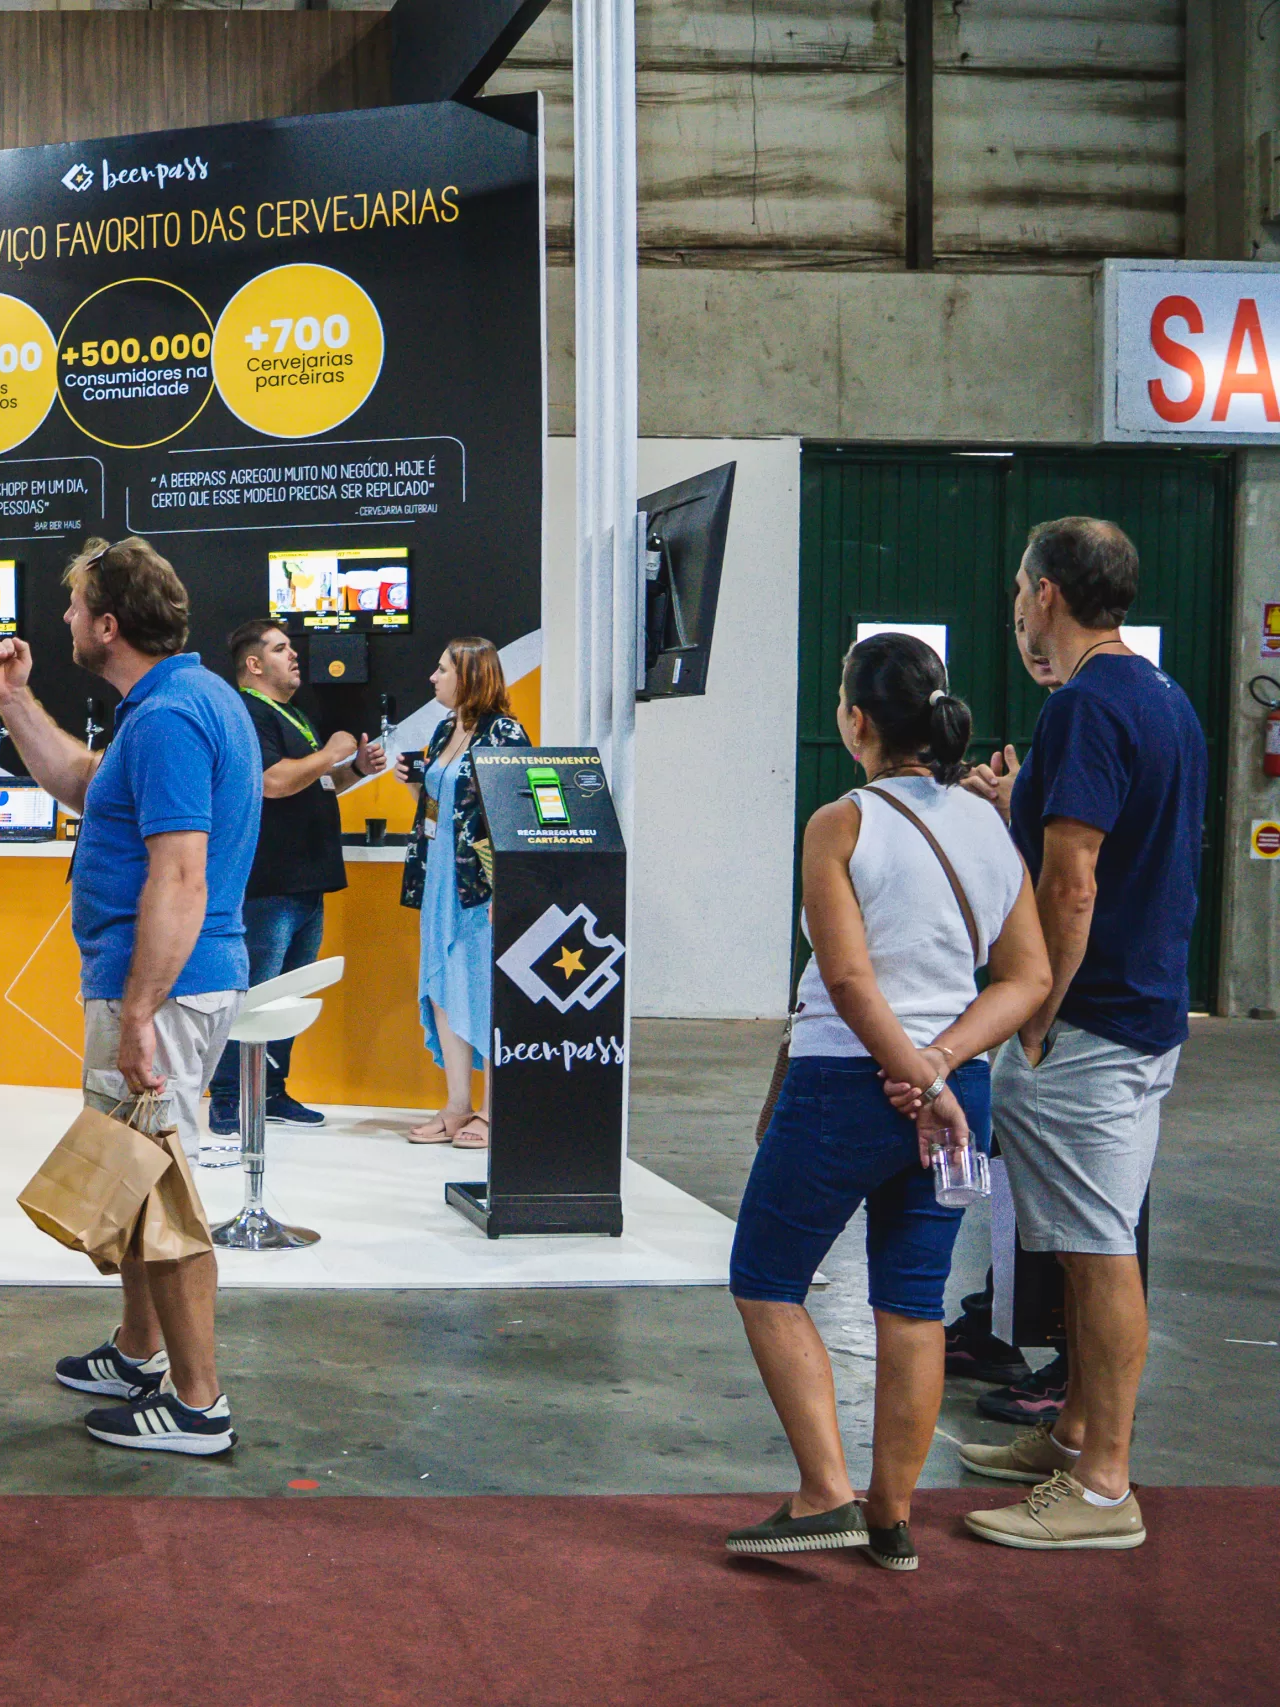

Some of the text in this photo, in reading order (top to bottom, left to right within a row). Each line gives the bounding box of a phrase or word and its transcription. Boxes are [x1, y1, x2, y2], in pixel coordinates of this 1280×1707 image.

[102, 156, 209, 191] beerpass
[56, 212, 181, 258] FAVORITO
[191, 205, 247, 245] DAS
[257, 186, 460, 239] CERVEJARIAS
[244, 314, 350, 353] +700
[62, 332, 211, 367] +500.000
[1148, 295, 1280, 423] SA
[247, 353, 353, 373] Cervejarias
[64, 366, 208, 387] Consumidores na
[256, 369, 345, 392] parceiras
[82, 381, 189, 401] Comunidade
[171, 470, 226, 488] BEERPASS
[229, 467, 281, 485] AGREGOU
[284, 465, 318, 482] MUITO
[321, 464, 337, 480] NO
[340, 456, 393, 479] NEGÓCIO.
[395, 460, 425, 476] HOJE
[428, 455, 436, 475] É
[31, 480, 45, 495] EM
[48, 479, 64, 494] UM
[66, 478, 88, 494] DIA,
[151, 492, 186, 508] CERTO
[189, 490, 210, 507] QUE
[213, 489, 240, 505] ESSE
[244, 487, 286, 504] MODELO
[289, 485, 337, 501] PRECISA
[340, 482, 362, 499] SER
[49, 520, 63, 530] BIER
[64, 520, 82, 529] HAUS
[475, 756, 601, 765] AUTOATENDIMENTO
[527, 835, 567, 844] CARTÃO
[494, 1027, 625, 1071] beerpass
